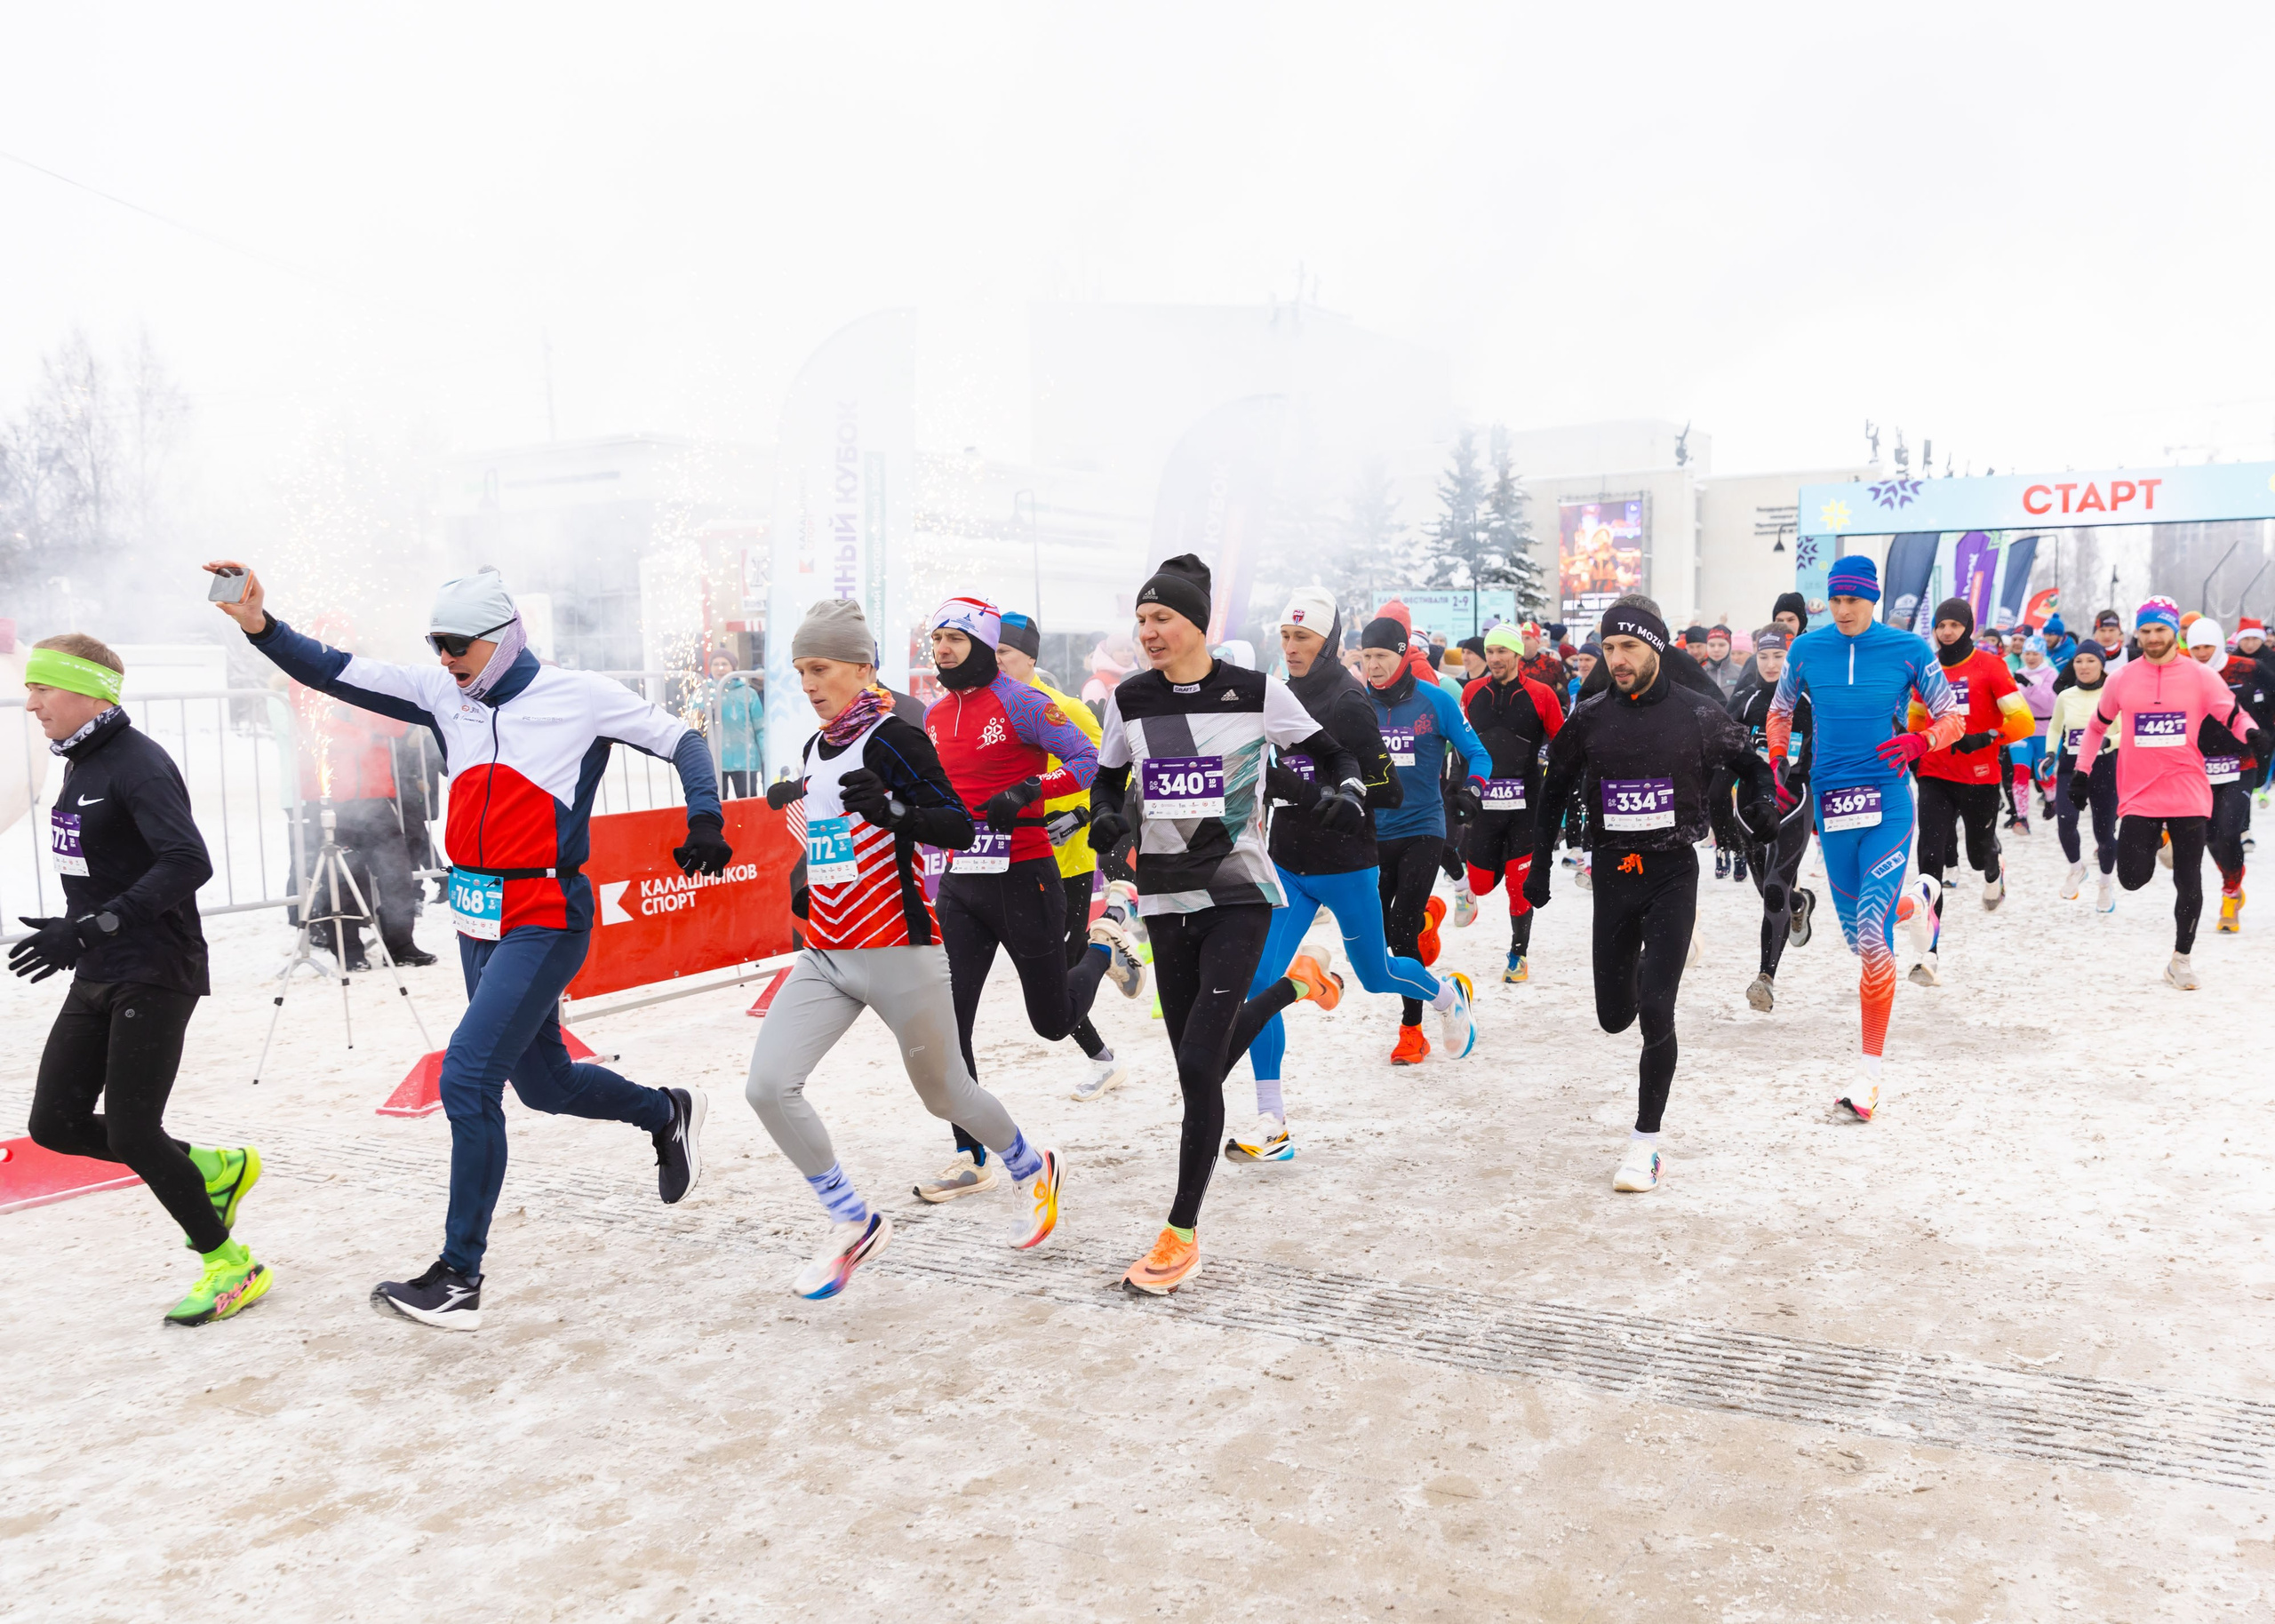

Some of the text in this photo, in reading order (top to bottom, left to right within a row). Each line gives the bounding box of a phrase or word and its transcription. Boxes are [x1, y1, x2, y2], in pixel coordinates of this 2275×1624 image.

[827, 399, 858, 600] ННЫЙ КУБОК
[2023, 479, 2162, 515] СТАРТ
[1452, 595, 1469, 608] 2-9
[1617, 622, 1635, 632] TY
[2144, 720, 2175, 735] 442
[2205, 761, 2231, 774] 350
[1158, 772, 1204, 796] 340
[1489, 786, 1513, 800] 416
[1616, 792, 1656, 811] 334
[1832, 794, 1866, 815] 369
[52, 825, 68, 851] 72
[641, 864, 758, 897] КАЛАШНИКОВ
[456, 885, 485, 914] 768
[641, 891, 697, 916] СПОРТ
